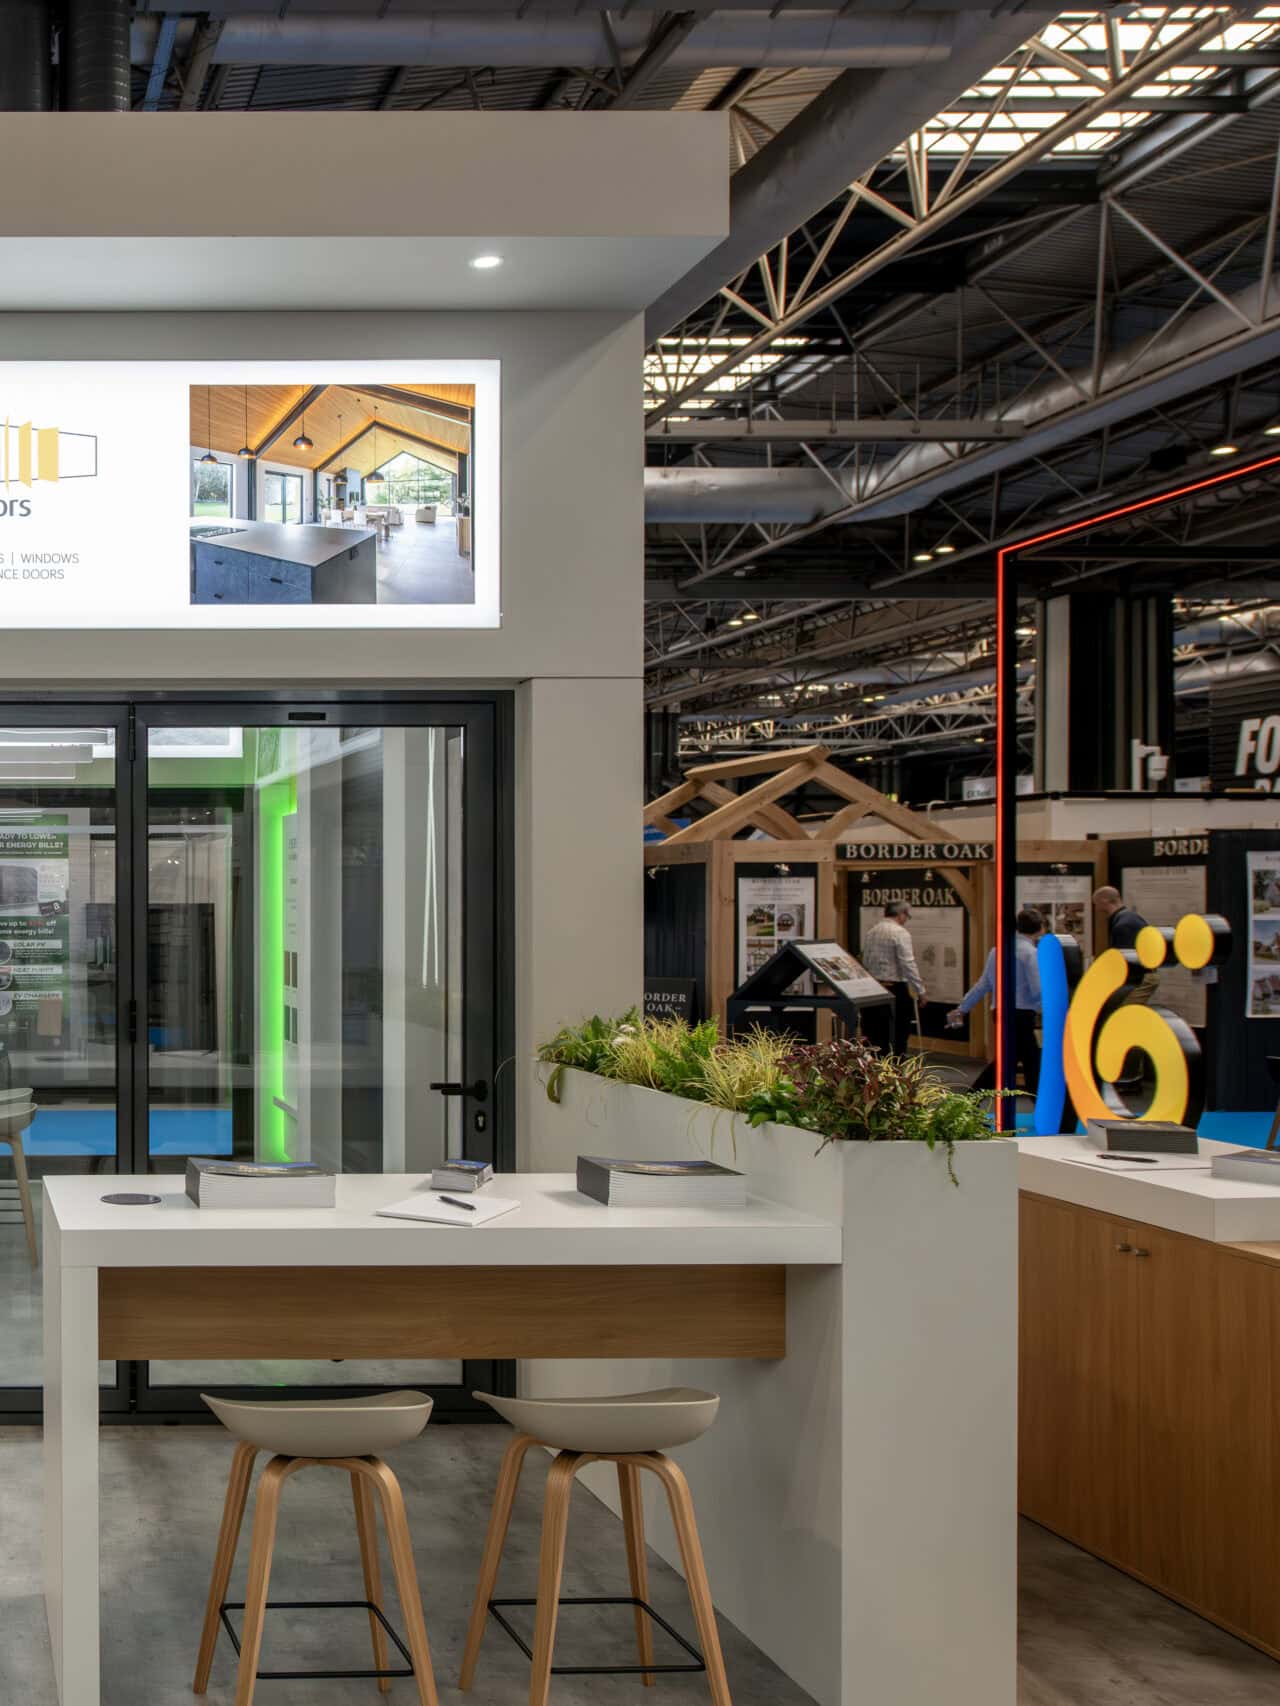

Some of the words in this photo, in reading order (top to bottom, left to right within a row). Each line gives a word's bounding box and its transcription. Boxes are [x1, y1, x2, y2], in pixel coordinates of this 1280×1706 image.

[20, 553, 80, 565] WINDOWS
[22, 569, 65, 580] DOORS
[845, 843, 937, 859] BORDER
[942, 843, 990, 859] OAK
[862, 888, 921, 905] BORDER
[922, 887, 957, 905] OAK
[647, 1002, 673, 1012] OAK
